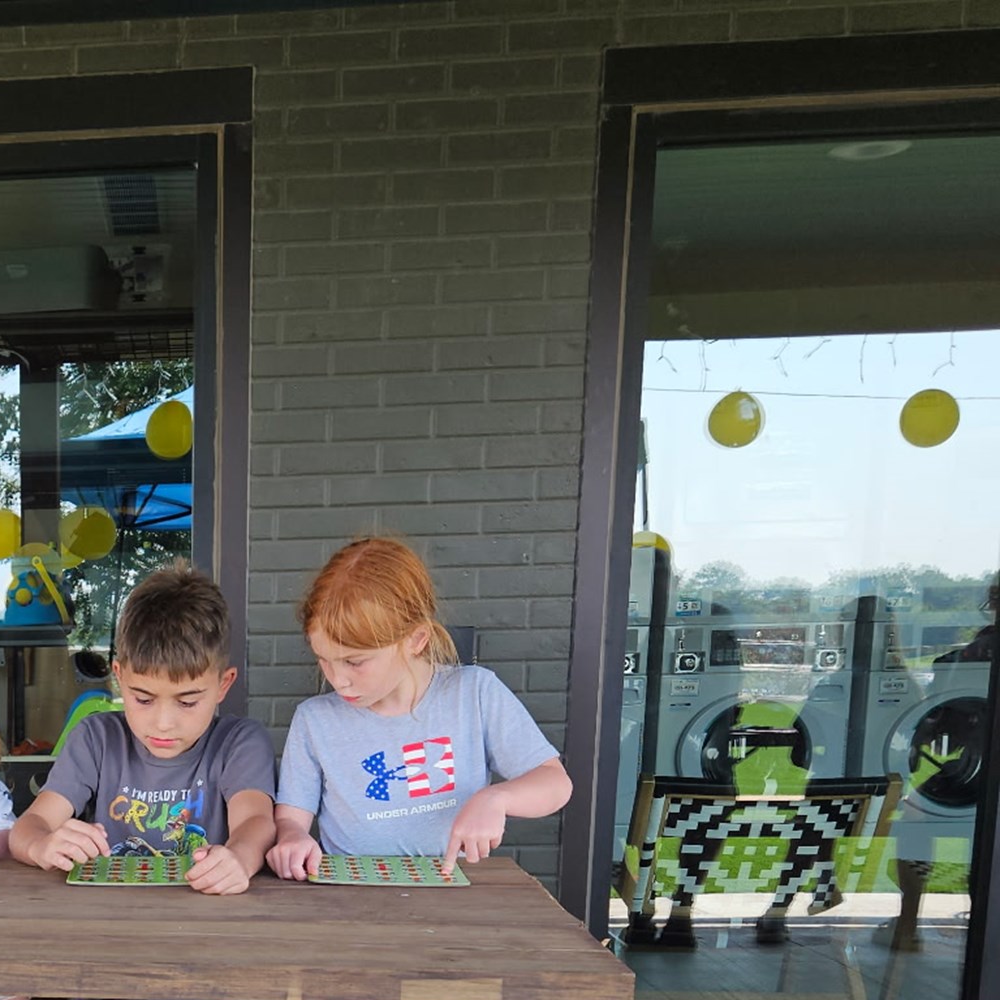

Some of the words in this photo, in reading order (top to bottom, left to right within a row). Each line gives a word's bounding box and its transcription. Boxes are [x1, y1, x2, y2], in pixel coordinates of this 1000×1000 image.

[131, 788, 146, 801] I'M
[148, 790, 177, 803] READY
[366, 808, 408, 820] UNDER
[410, 799, 457, 815] ARMOUR
